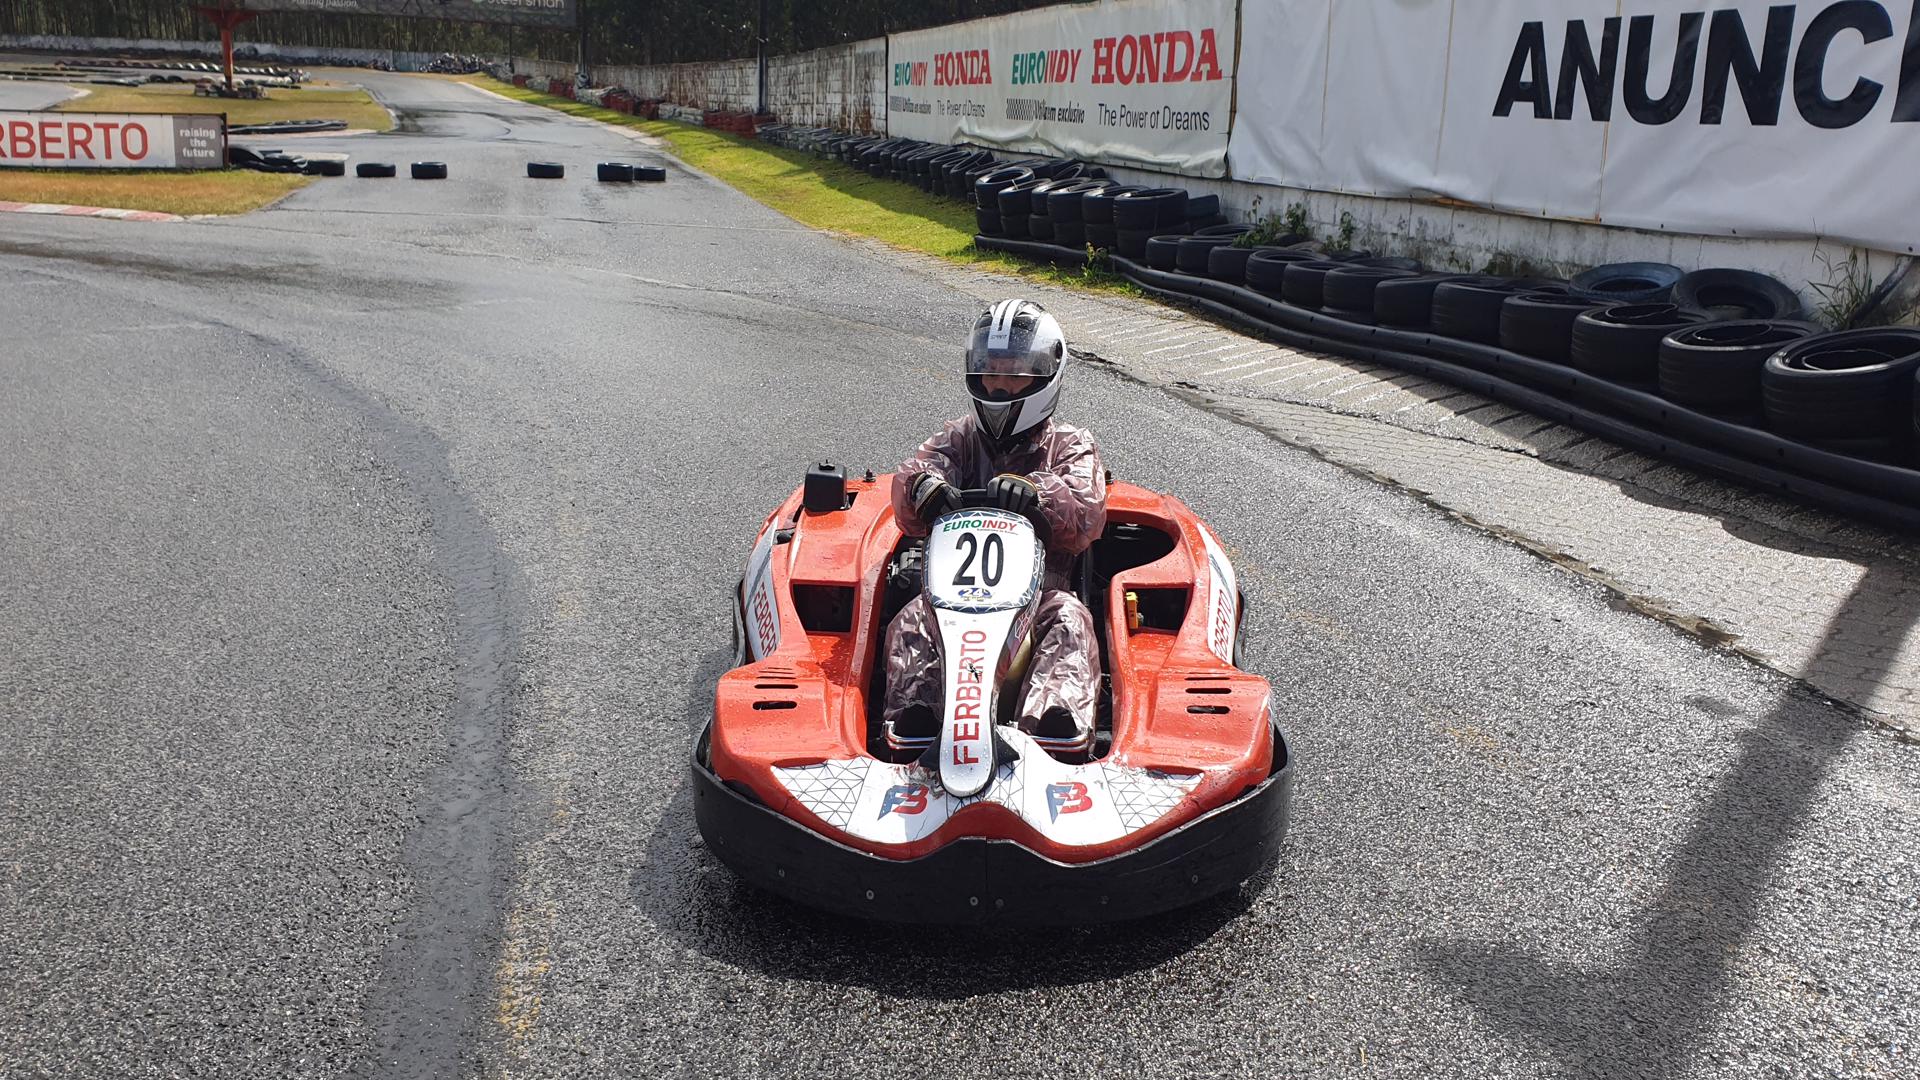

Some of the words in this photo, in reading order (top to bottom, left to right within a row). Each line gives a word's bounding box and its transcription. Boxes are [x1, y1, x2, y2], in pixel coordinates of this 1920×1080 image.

[934, 48, 992, 87] HONDA
[1090, 28, 1223, 86] HONDA
[180, 127, 216, 139] raising
[1098, 103, 1117, 127] The
[1119, 104, 1149, 128] Power
[1149, 108, 1161, 129] of
[1162, 105, 1210, 131] Dreams
[182, 147, 216, 158] future
[190, 137, 207, 148] the
[943, 519, 1017, 532] EUROINDY
[952, 532, 1005, 587] 20
[753, 581, 777, 657] FERBER
[1214, 588, 1232, 662] RBERTO
[953, 630, 987, 766] FERBERTO
